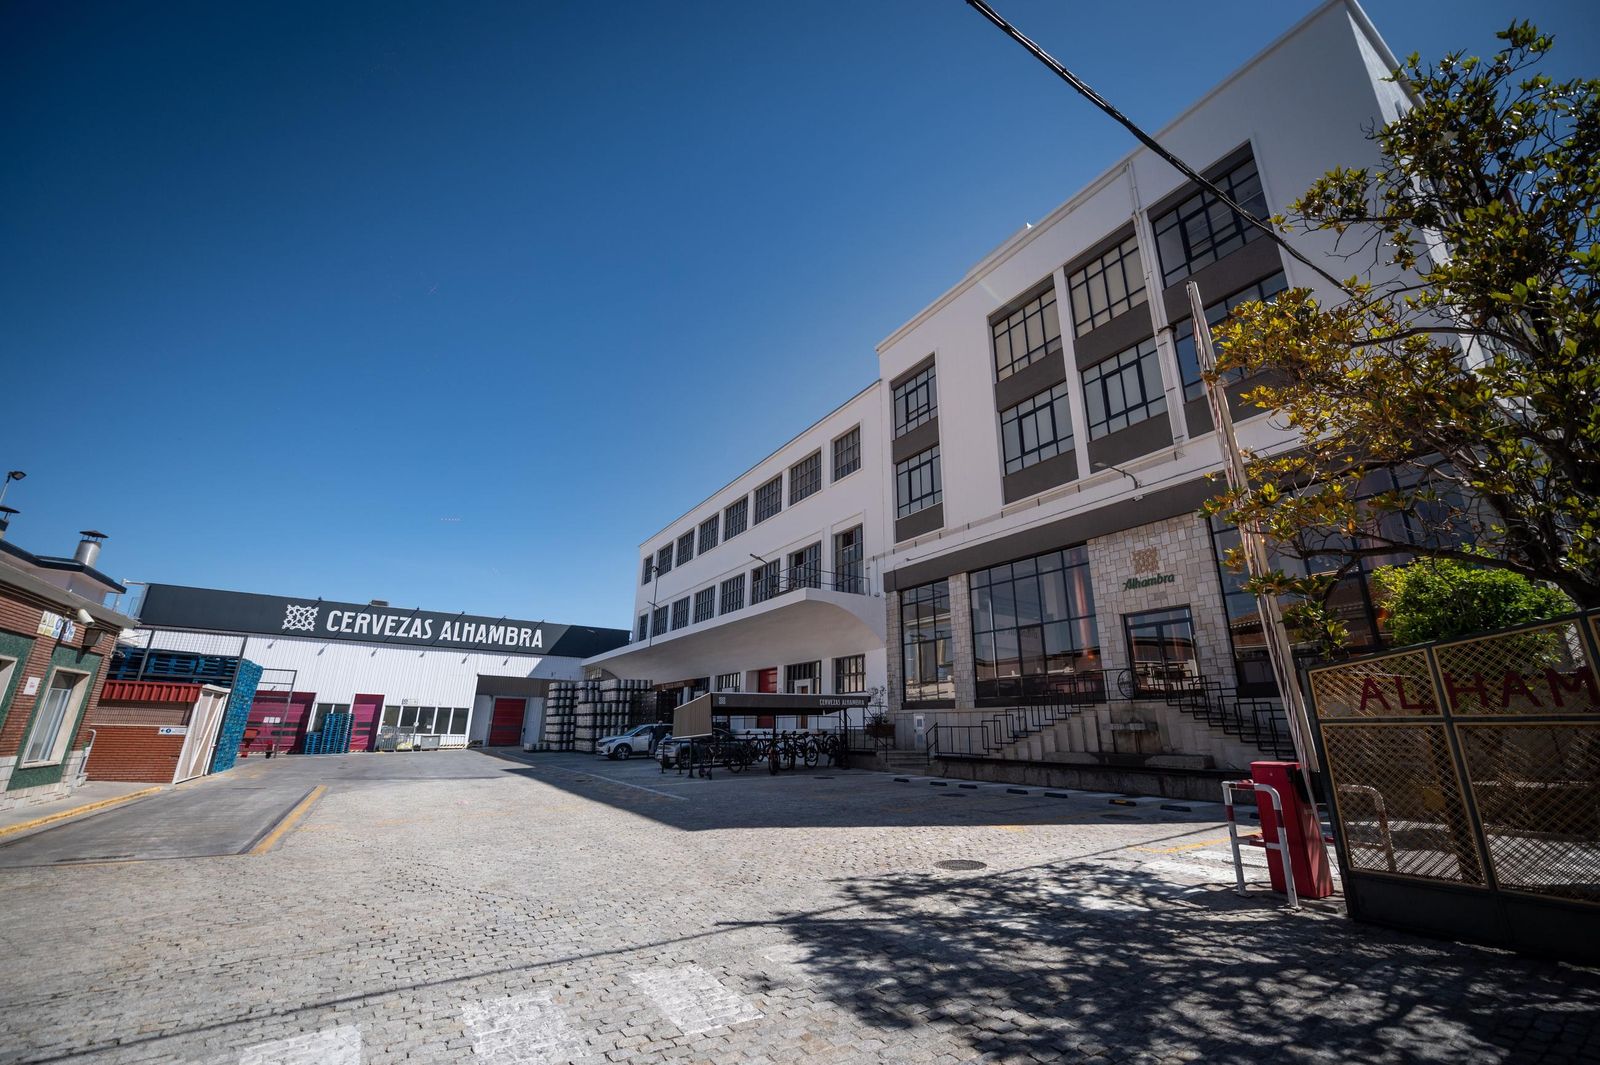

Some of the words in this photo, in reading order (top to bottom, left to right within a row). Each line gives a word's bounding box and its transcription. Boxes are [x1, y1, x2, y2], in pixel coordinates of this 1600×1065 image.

[1122, 573, 1175, 592] Alhambra
[326, 610, 433, 640] CERVEZAS
[438, 621, 543, 648] ALHAMBRA
[819, 698, 840, 706] CERVEZAS
